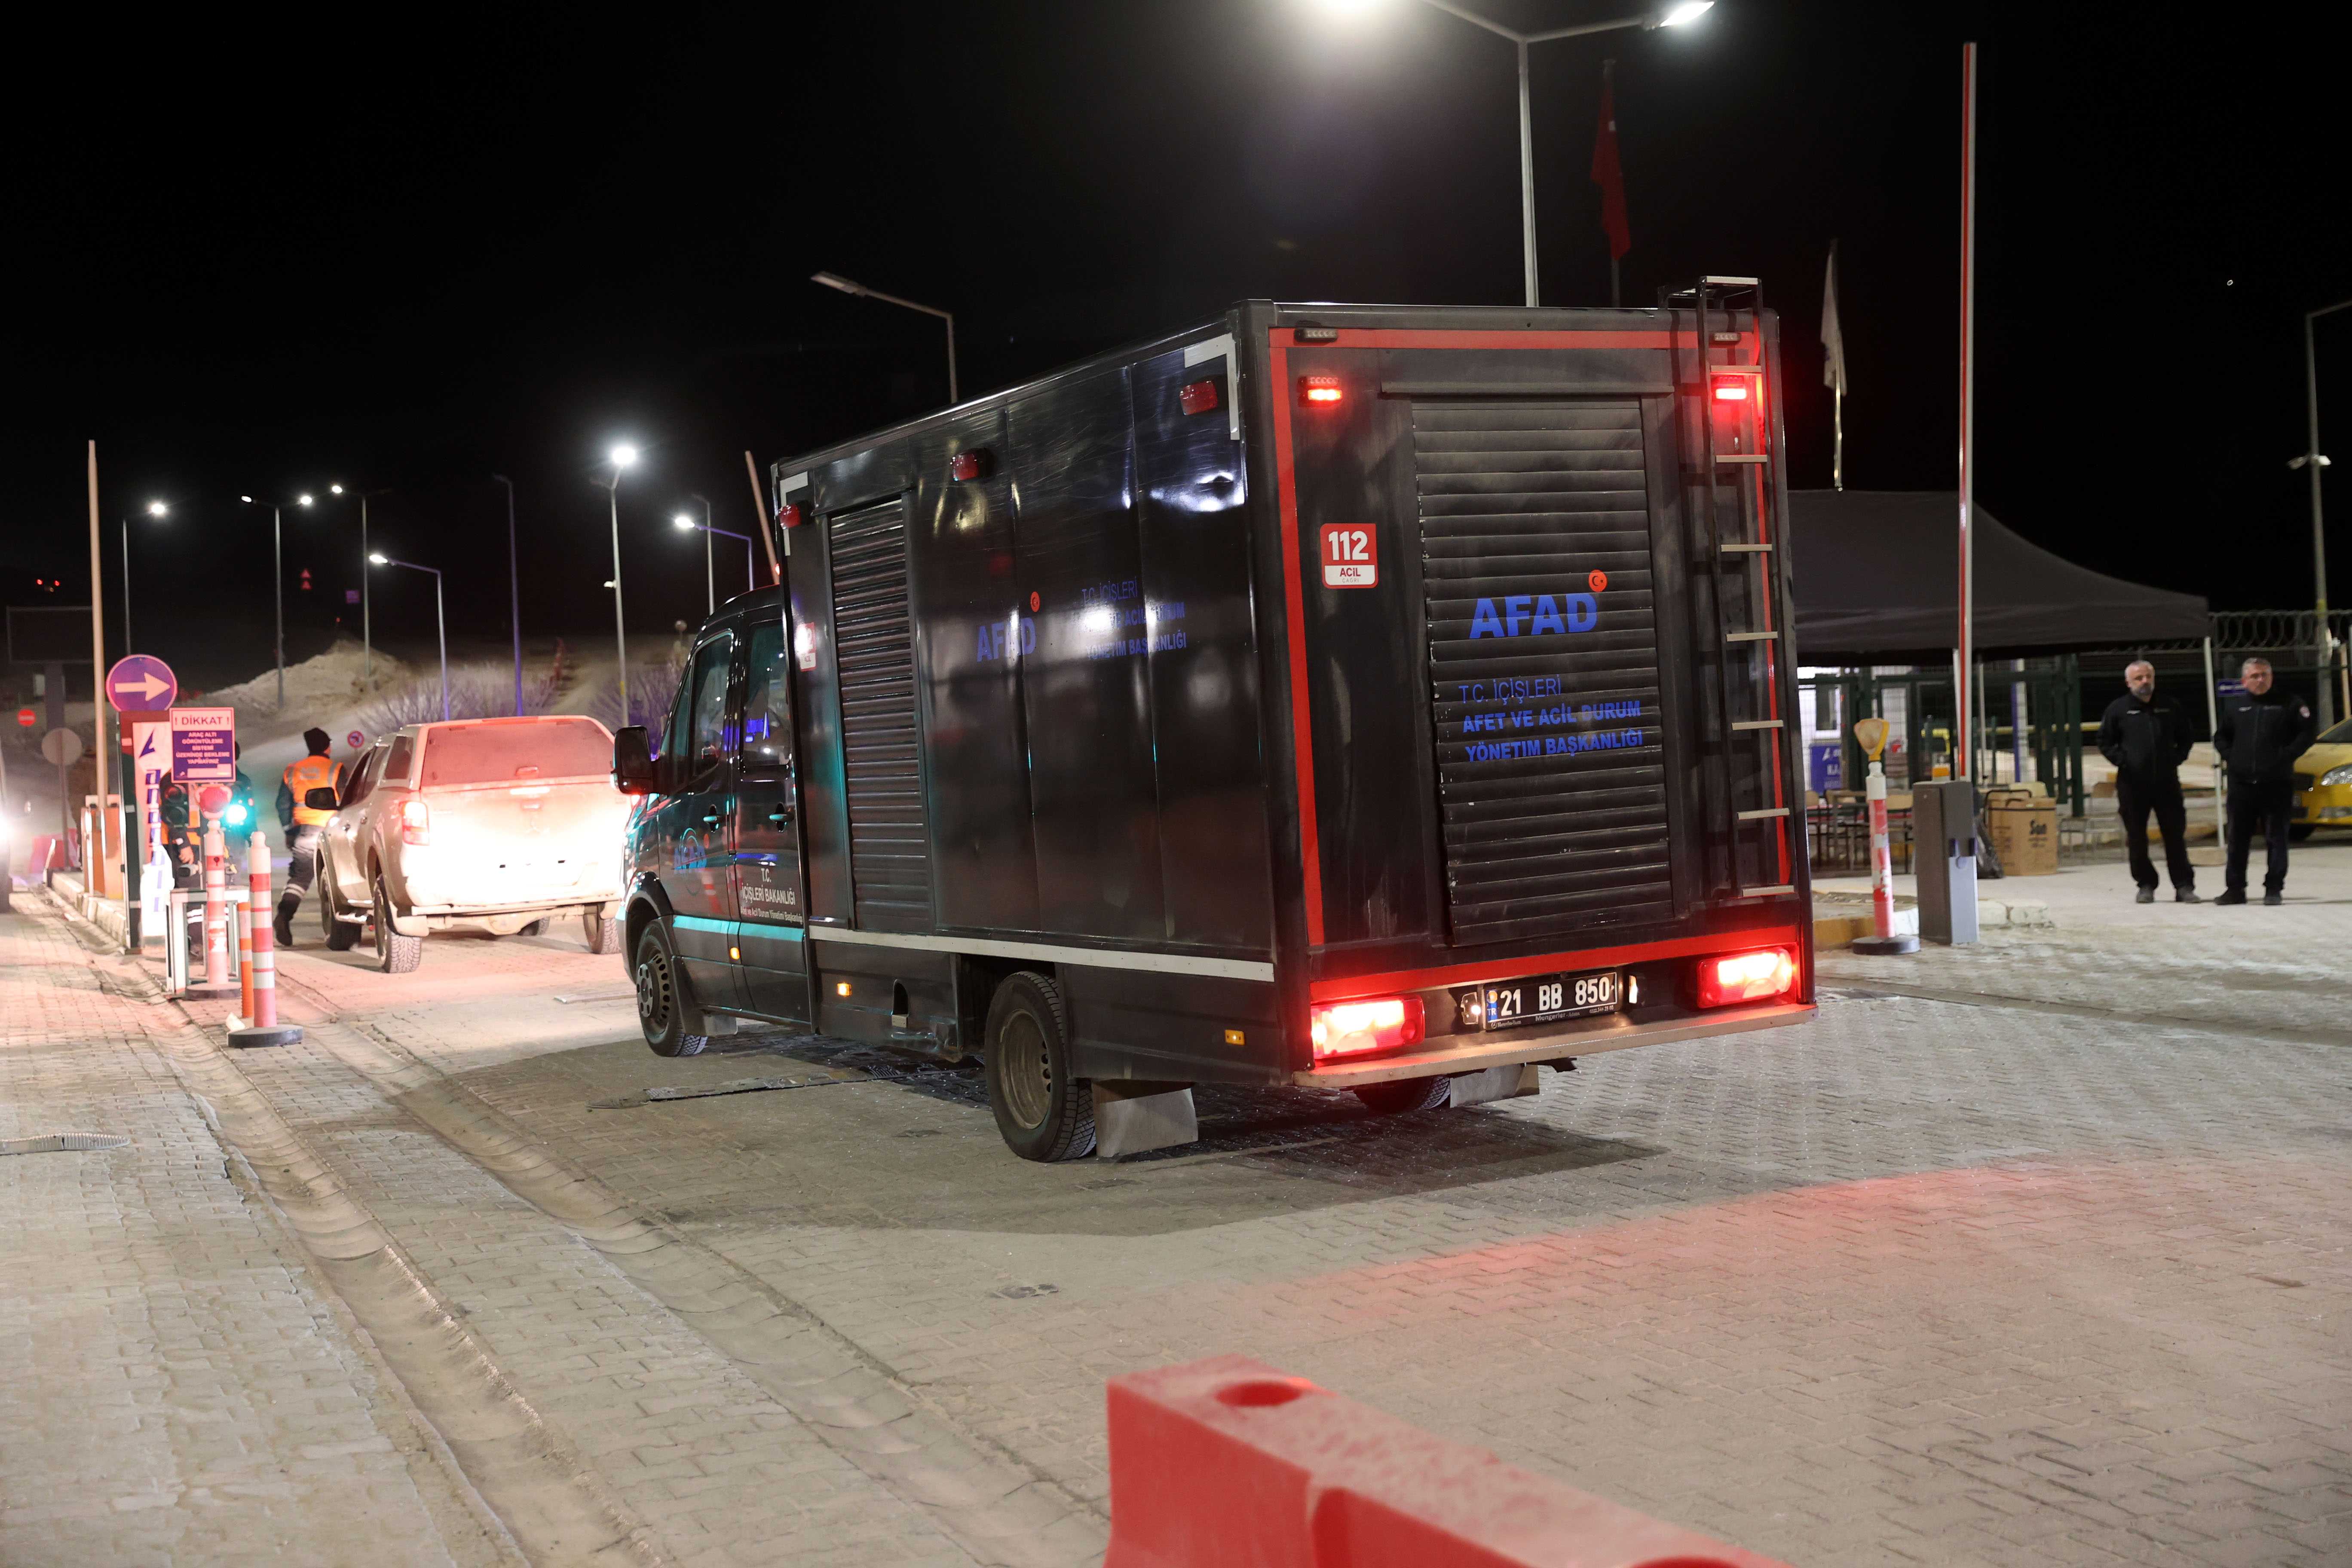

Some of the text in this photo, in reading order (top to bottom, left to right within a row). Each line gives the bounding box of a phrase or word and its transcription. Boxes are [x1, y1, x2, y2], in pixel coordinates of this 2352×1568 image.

[1329, 531, 1369, 560] 112
[1469, 593, 1597, 639] AFAD
[1129, 629, 1186, 657] BAŞANLIĞI
[1492, 674, 1562, 705] İÇİŞLERİ
[182, 715, 223, 725] DİKKAT
[1463, 700, 1641, 732] AFET VE ACİL DURUM
[1545, 727, 1643, 756] BAŞKANLIĞI
[761, 868, 772, 882] T.C.
[742, 882, 796, 905] İÇİŞLERİ BAKANLIĞI
[1500, 977, 1610, 1016] 21 BB 850
[1487, 1008, 1496, 1016] TR
